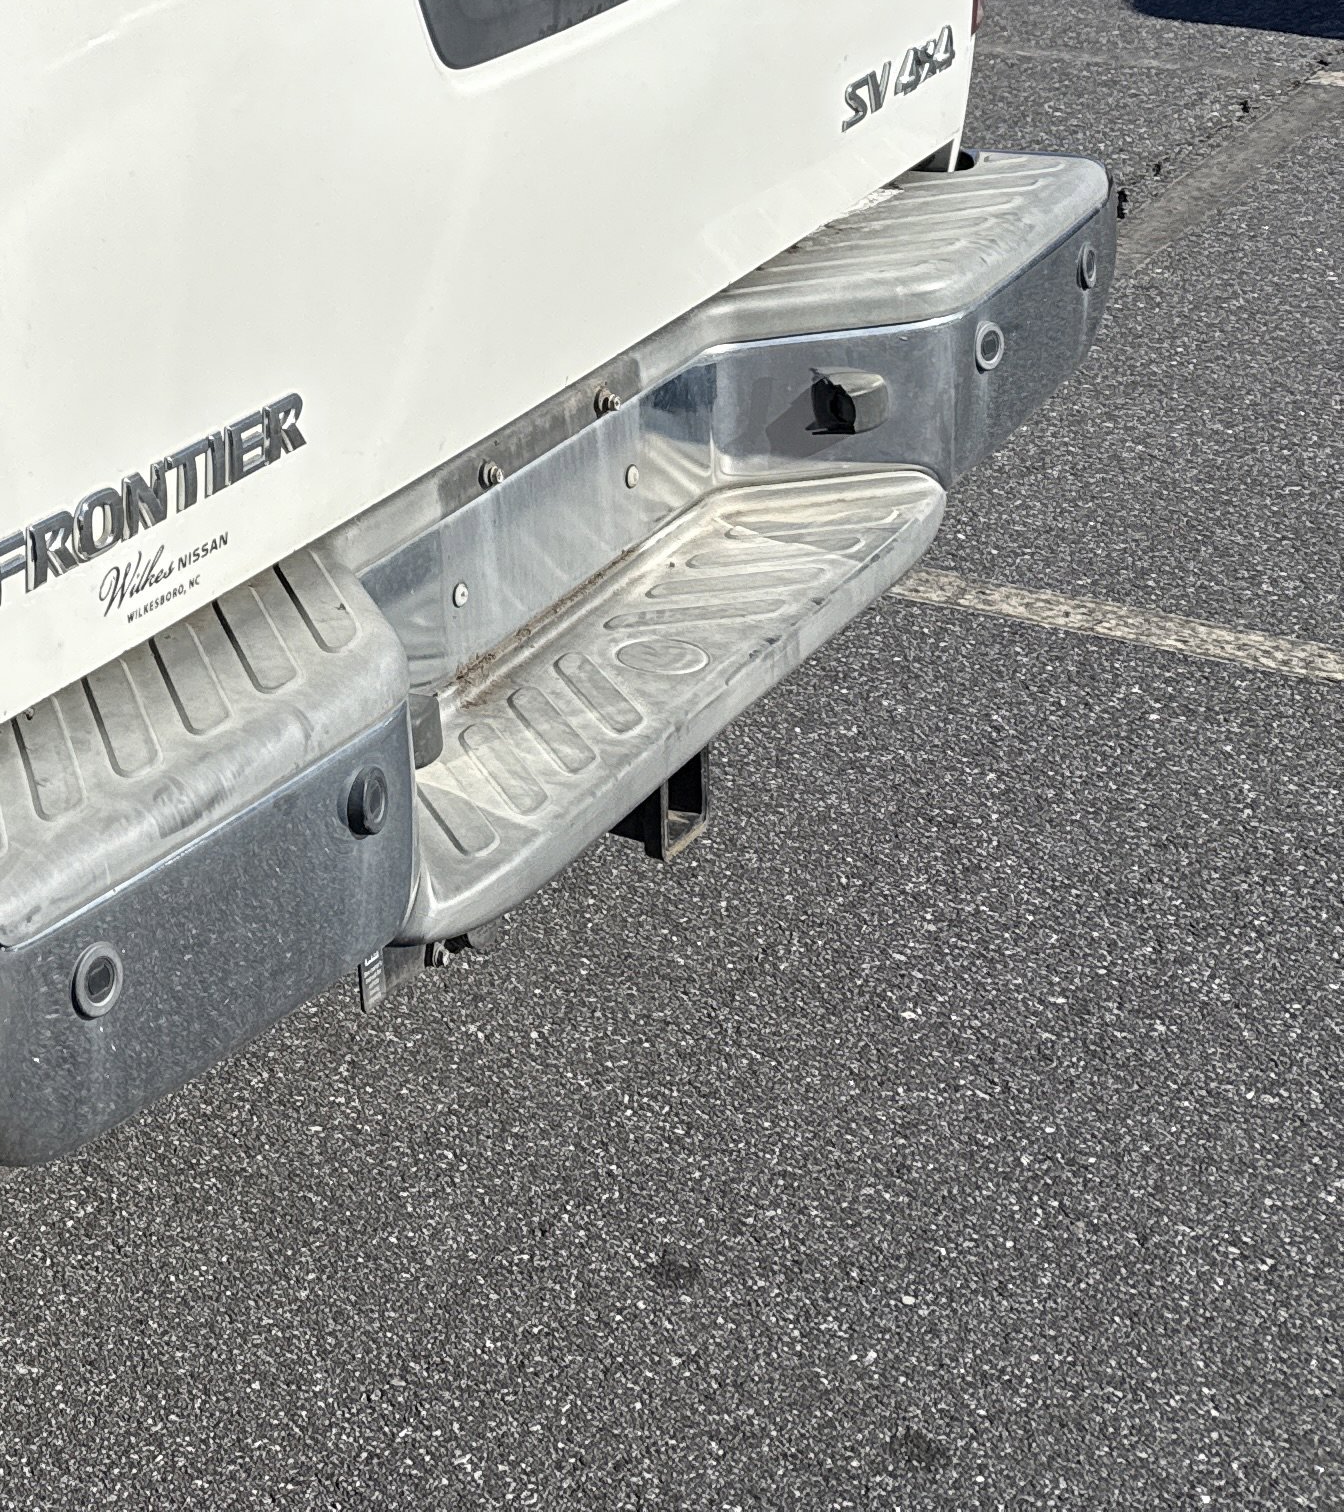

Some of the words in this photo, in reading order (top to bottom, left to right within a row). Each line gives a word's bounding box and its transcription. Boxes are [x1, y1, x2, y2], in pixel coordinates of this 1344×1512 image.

[841, 60, 892, 133] SV
[98, 544, 176, 617] Wilkes
[177, 531, 229, 572] NISSAN
[127, 587, 187, 624] WILKESBORO,
[188, 574, 201, 590] NC
